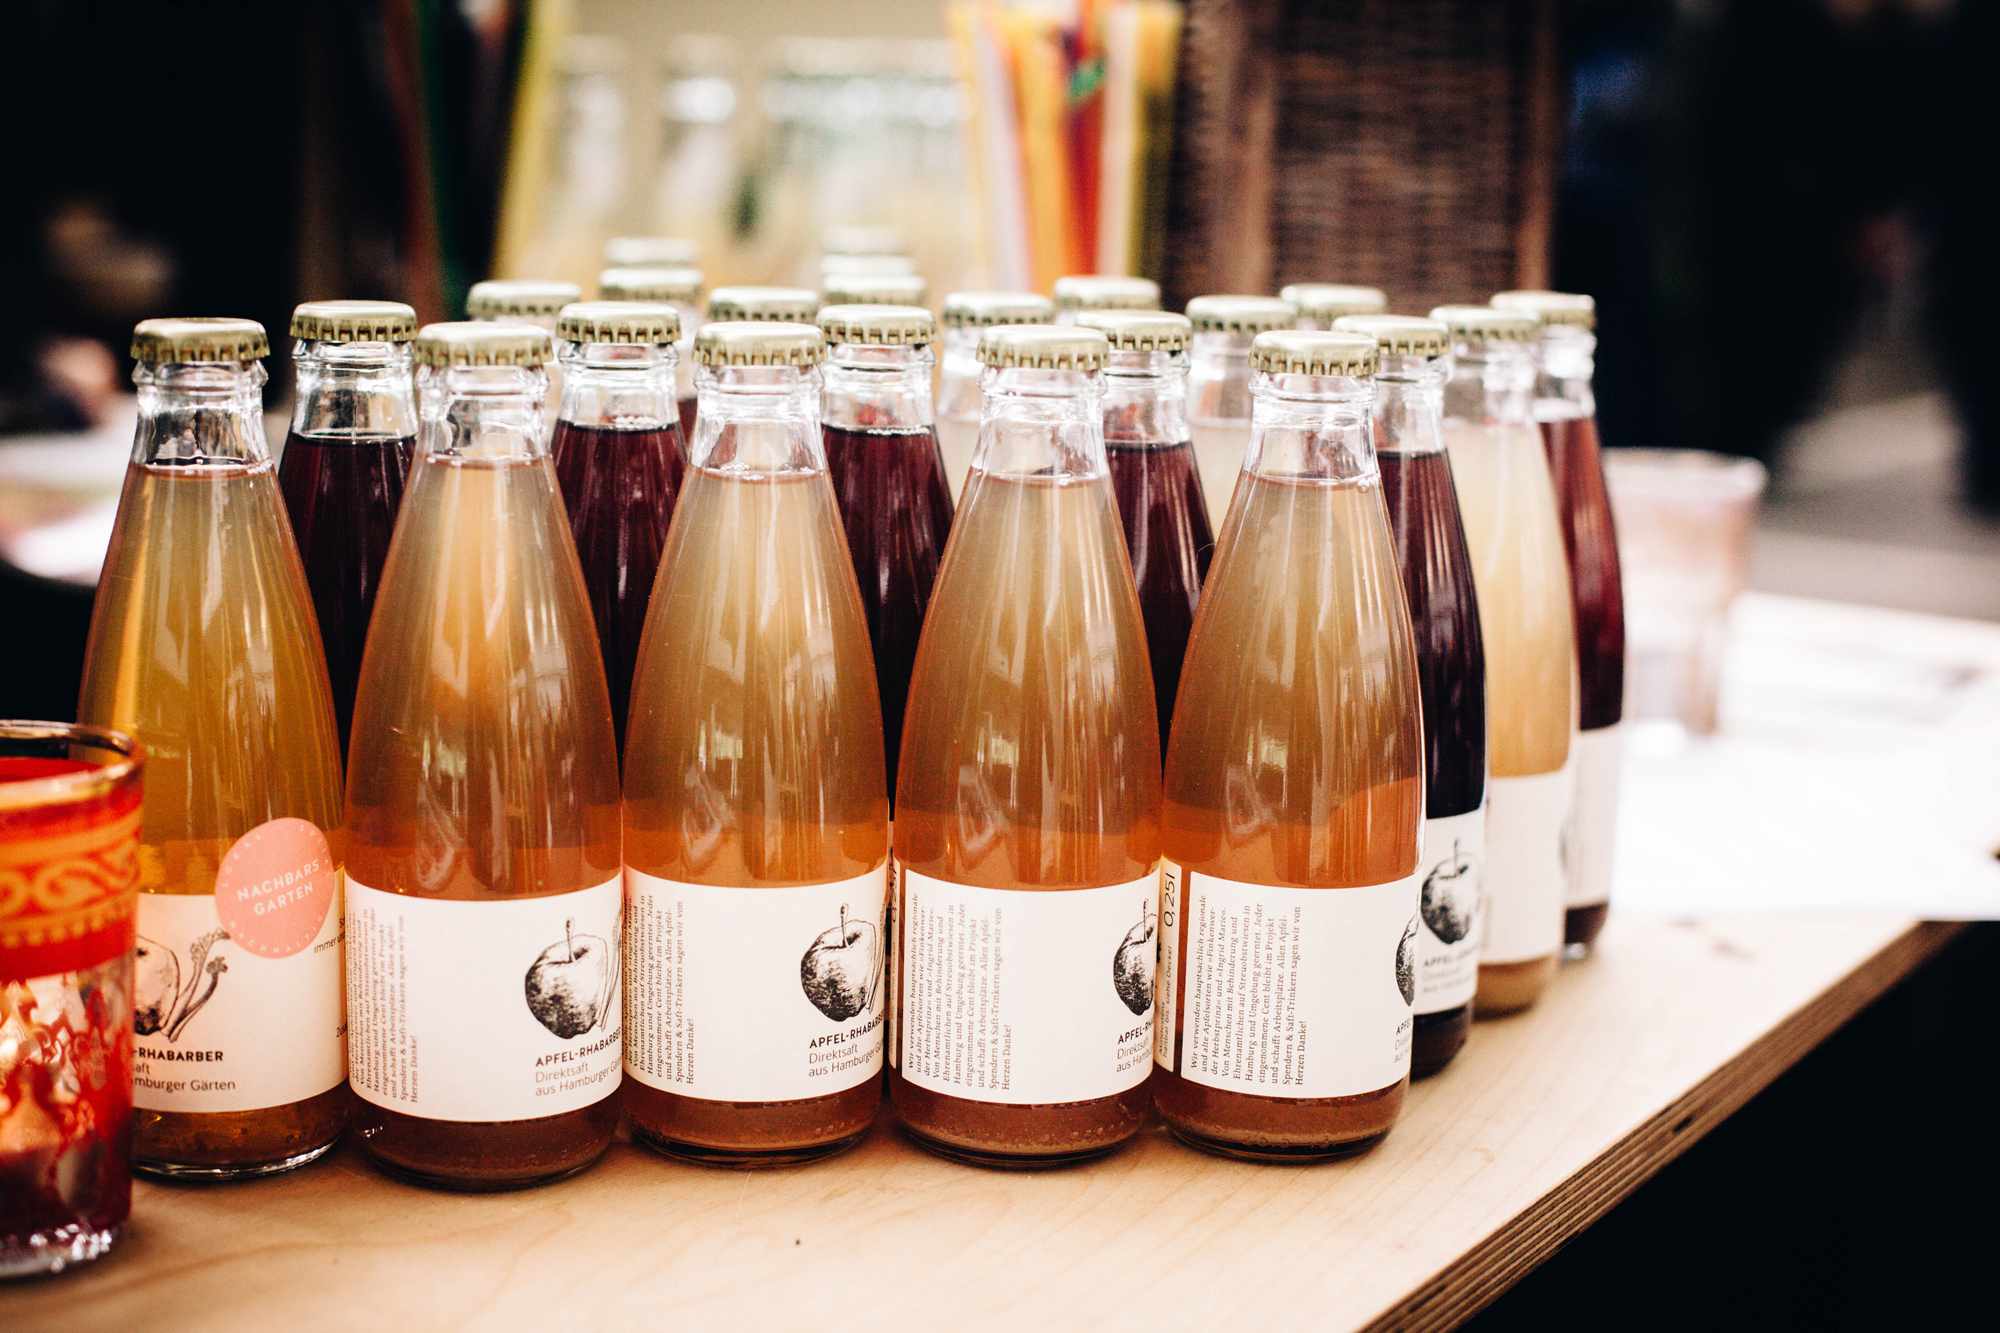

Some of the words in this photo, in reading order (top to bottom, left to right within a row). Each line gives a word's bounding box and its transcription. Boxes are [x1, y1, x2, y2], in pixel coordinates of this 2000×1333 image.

[236, 858, 320, 903] NACHBARS
[253, 881, 313, 917] GARTEN
[1198, 896, 1208, 936] regionale
[1243, 906, 1250, 915] in
[1266, 918, 1276, 950] Projekt
[995, 946, 1003, 971] sagen
[1227, 938, 1239, 994] Behinderung
[1239, 918, 1249, 991] Streuobstwiesen
[1265, 952, 1272, 964] im
[1292, 945, 1301, 968] sagen
[991, 975, 1000, 1035] Saft-Trinkern
[1203, 983, 1212, 1033] Apfelsorten
[1249, 971, 1262, 1017] Umgebung
[1272, 1035, 1280, 1064] schafft
[1277, 945, 1285, 969] Allen
[1286, 971, 1296, 1032] Saft-Trinkern
[809, 1043, 858, 1065] Direktsaft
[1223, 1014, 1232, 1057] Menschen
[1234, 1010, 1244, 1079] Ehrenamtlichen
[1259, 1017, 1270, 1083] eingenommene
[1298, 1021, 1307, 1052] Danke!
[535, 1062, 588, 1083] Direktsaft
[675, 1041, 685, 1082] Spendern
[808, 1066, 829, 1078] aus
[990, 1048, 1000, 1088] Spendern
[1116, 1061, 1132, 1073] aus
[1246, 1040, 1258, 1081] Hamburg
[1282, 1044, 1293, 1084] Spendern
[1296, 1054, 1305, 1085] Herzen
[190, 1079, 236, 1091] Gärten
[535, 1085, 556, 1096] aus
